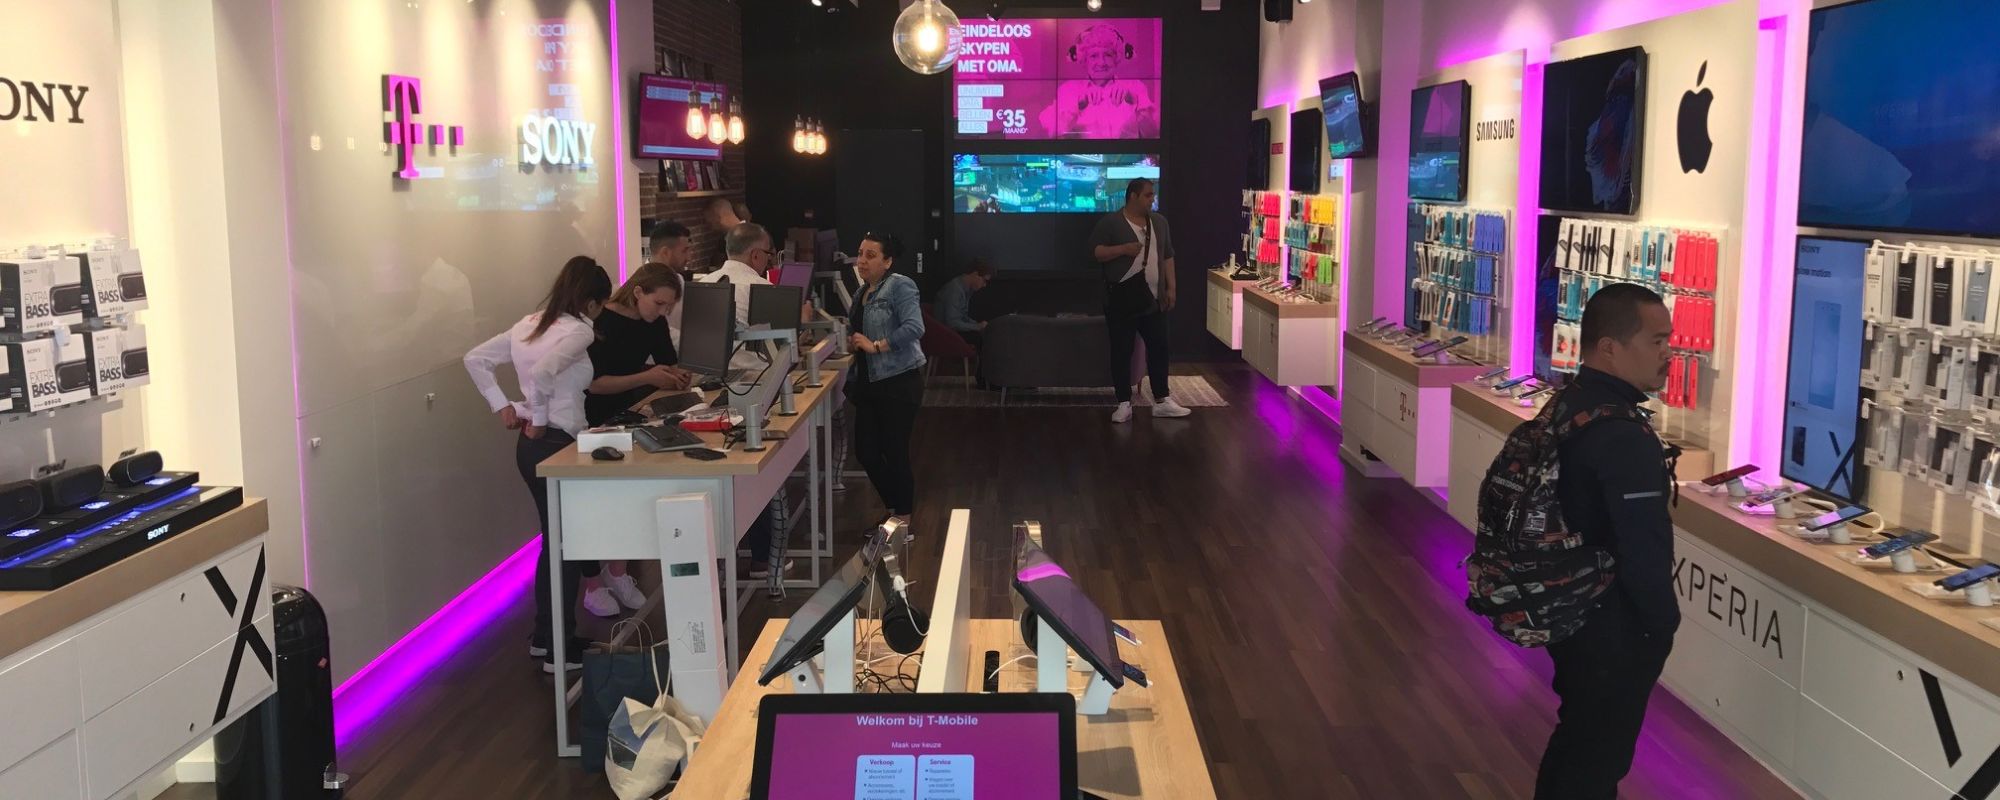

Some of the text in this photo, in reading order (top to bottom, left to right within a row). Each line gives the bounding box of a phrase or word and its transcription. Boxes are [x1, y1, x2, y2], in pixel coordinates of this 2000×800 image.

[958, 24, 1032, 38] EINDELOOS
[958, 42, 1010, 55] SKYPEN
[957, 60, 1022, 72] MET OMA.
[0, 77, 89, 124] ONY
[1476, 118, 1516, 142] SAMSUNG
[520, 114, 597, 167] SONY
[24, 290, 48, 306] EXTRA
[98, 290, 120, 304] BASS
[25, 303, 50, 319] BASS
[29, 368, 54, 384] EXTRA
[99, 367, 121, 382] BASS
[31, 380, 57, 398] BASS
[147, 524, 170, 540] SONY
[1672, 557, 1783, 660] XPERIA
[856, 715, 979, 728] Welkom bij T-Mobile
